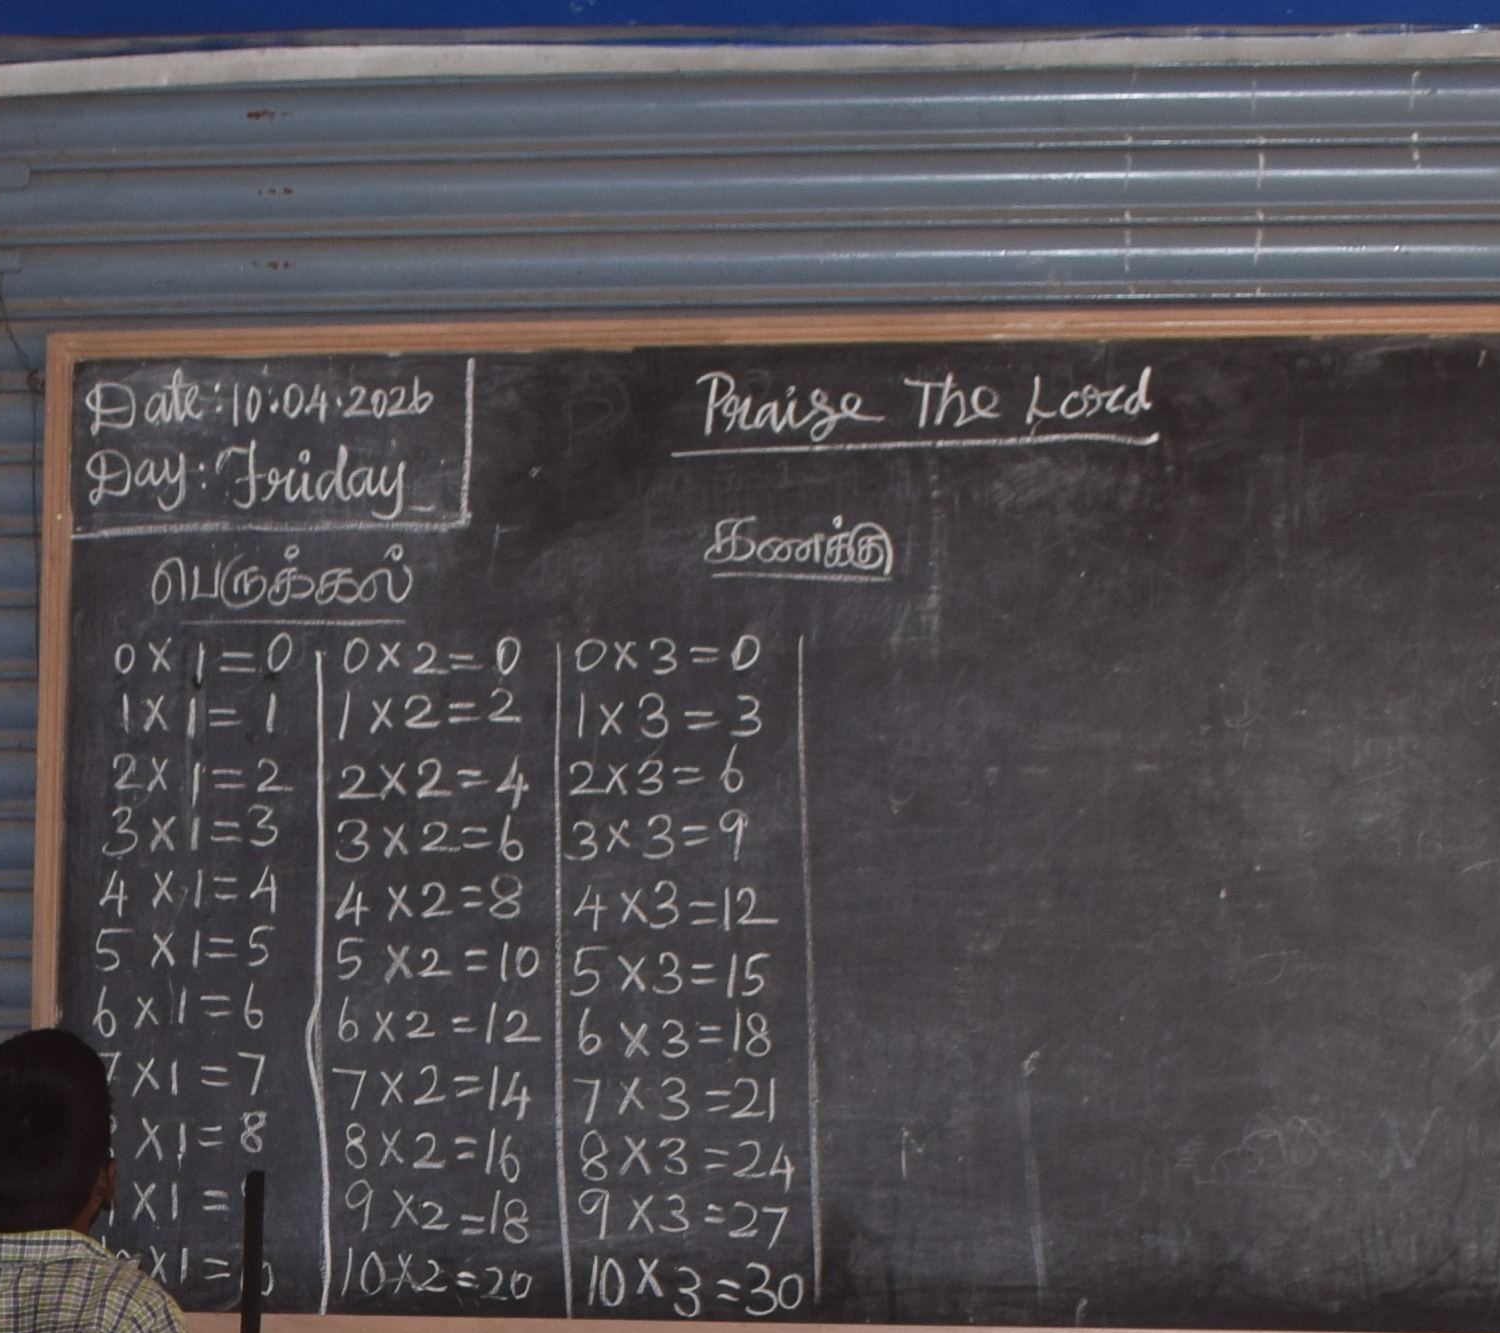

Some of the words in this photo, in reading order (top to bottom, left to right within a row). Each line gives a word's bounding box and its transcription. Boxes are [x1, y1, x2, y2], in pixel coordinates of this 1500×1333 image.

[904, 372, 1000, 429] The
[1026, 366, 1152, 426] Lord
[215, 439, 406, 520] Friday
